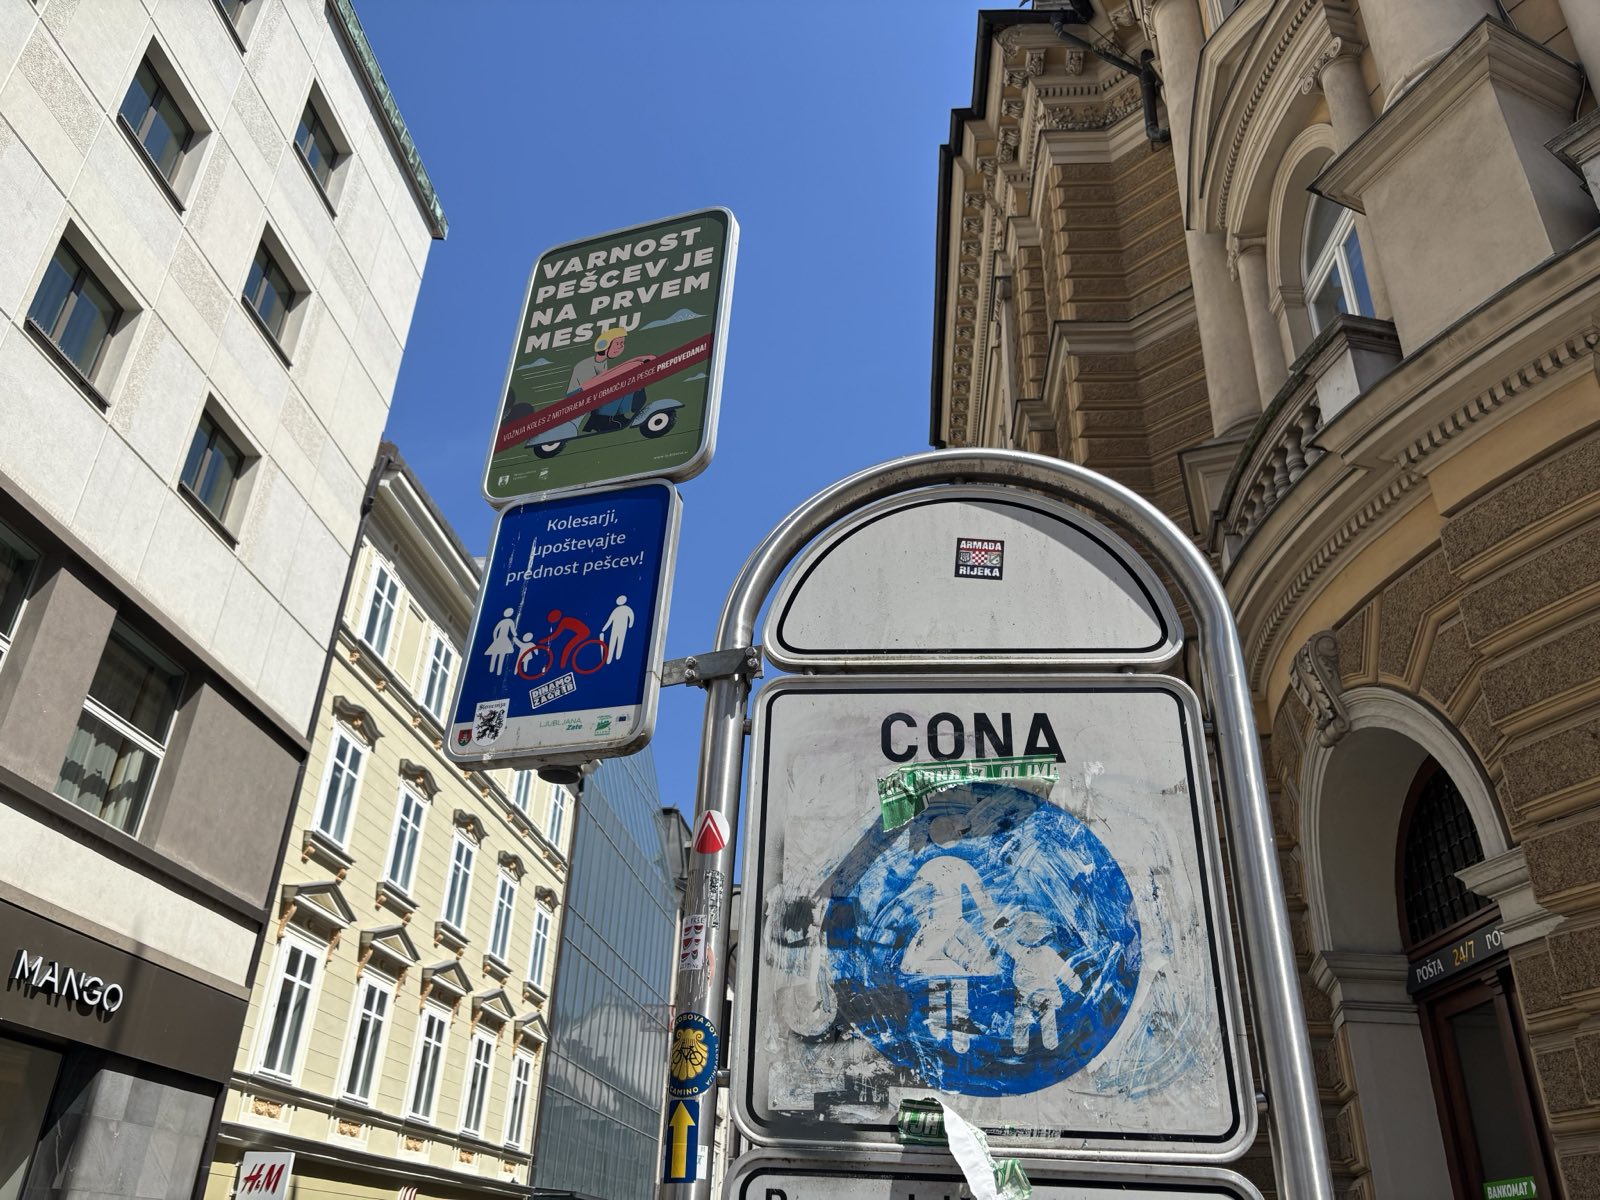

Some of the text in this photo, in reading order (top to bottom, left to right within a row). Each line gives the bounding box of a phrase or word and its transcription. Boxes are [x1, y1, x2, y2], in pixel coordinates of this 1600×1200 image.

[543, 227, 701, 279] VARNOST
[536, 247, 714, 304] PEŠCEV JE
[530, 272, 710, 329] NA PRVEM
[525, 312, 641, 353] MESTU
[527, 417, 546, 431] KOLES
[584, 396, 592, 405] JE
[627, 376, 636, 386] ZA
[656, 342, 707, 372] PREPOVEDANA!
[547, 509, 618, 531] Kolesarji,
[533, 532, 626, 558] upoštevajte
[960, 541, 1001, 550] ARMADA
[505, 551, 644, 586] prednost pešcev!
[959, 566, 1000, 577] RIJEKA
[532, 675, 572, 698] DINAMO
[533, 683, 574, 706] ZAGREB
[540, 717, 582, 728] LJUBLJANA
[881, 712, 1066, 763] CONA
[1416, 959, 1444, 983] POŠTA
[1452, 940, 1475, 967] 24/7
[15, 949, 123, 1013] MANGO
[705, 1022, 718, 1037] POT
[669, 1086, 699, 1096] CAMINO
[240, 1163, 286, 1195] H&M
[1486, 1181, 1528, 1199] BANKOMAT
